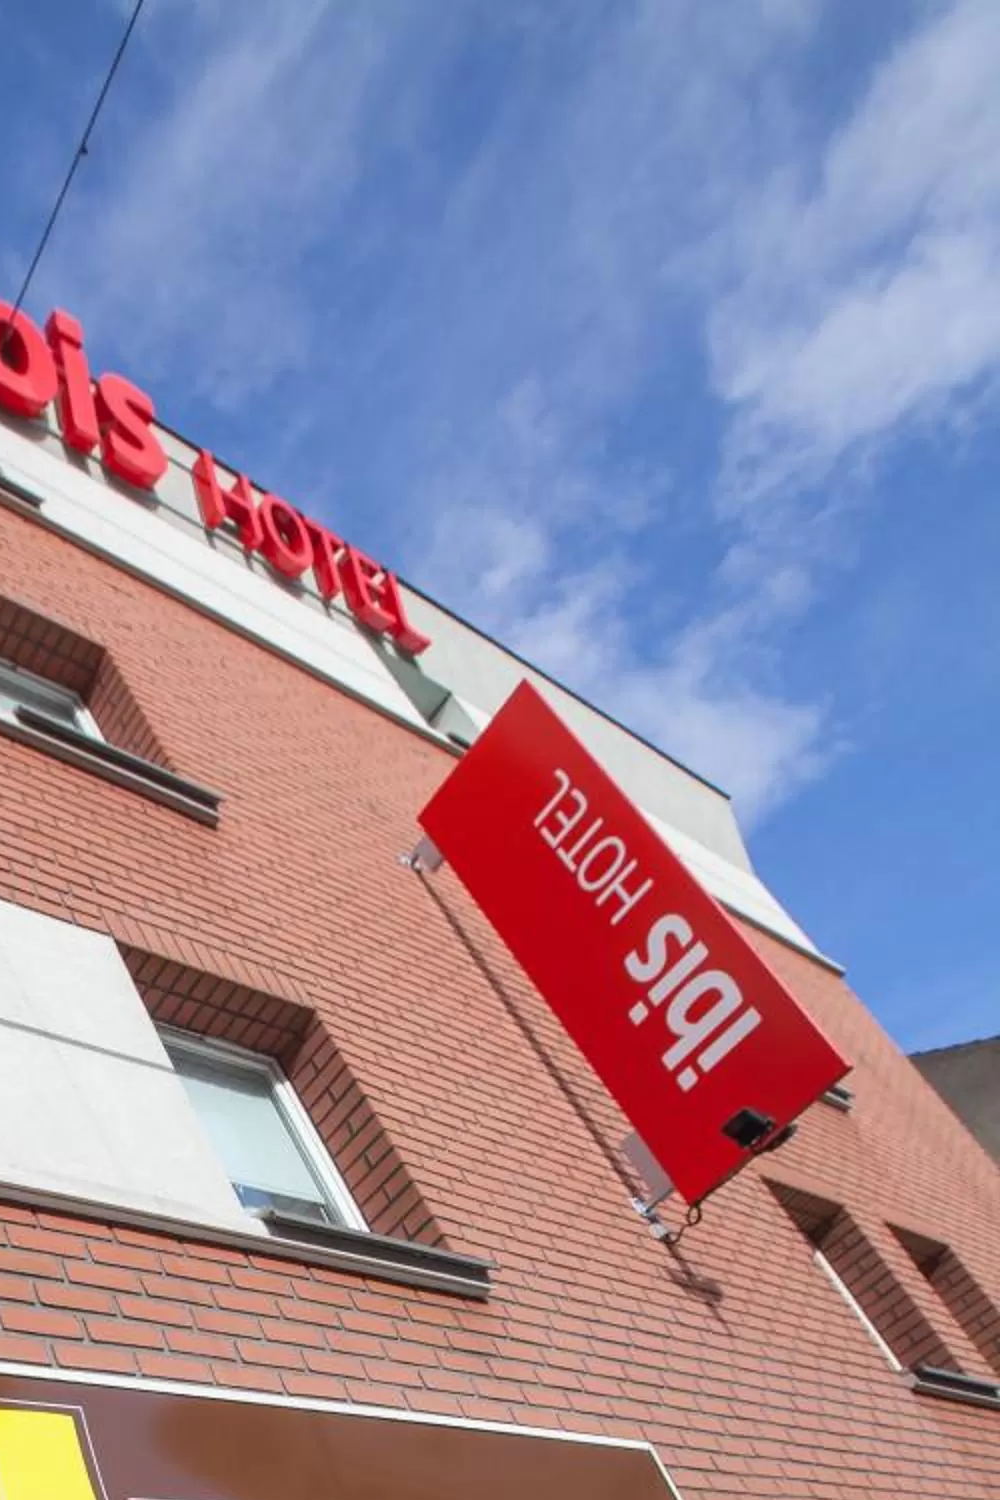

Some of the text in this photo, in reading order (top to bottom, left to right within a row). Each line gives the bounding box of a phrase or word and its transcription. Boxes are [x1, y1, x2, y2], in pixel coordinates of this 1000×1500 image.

[192, 449, 431, 656] HOTEL
[532, 767, 763, 1093] ibis HOTEL
